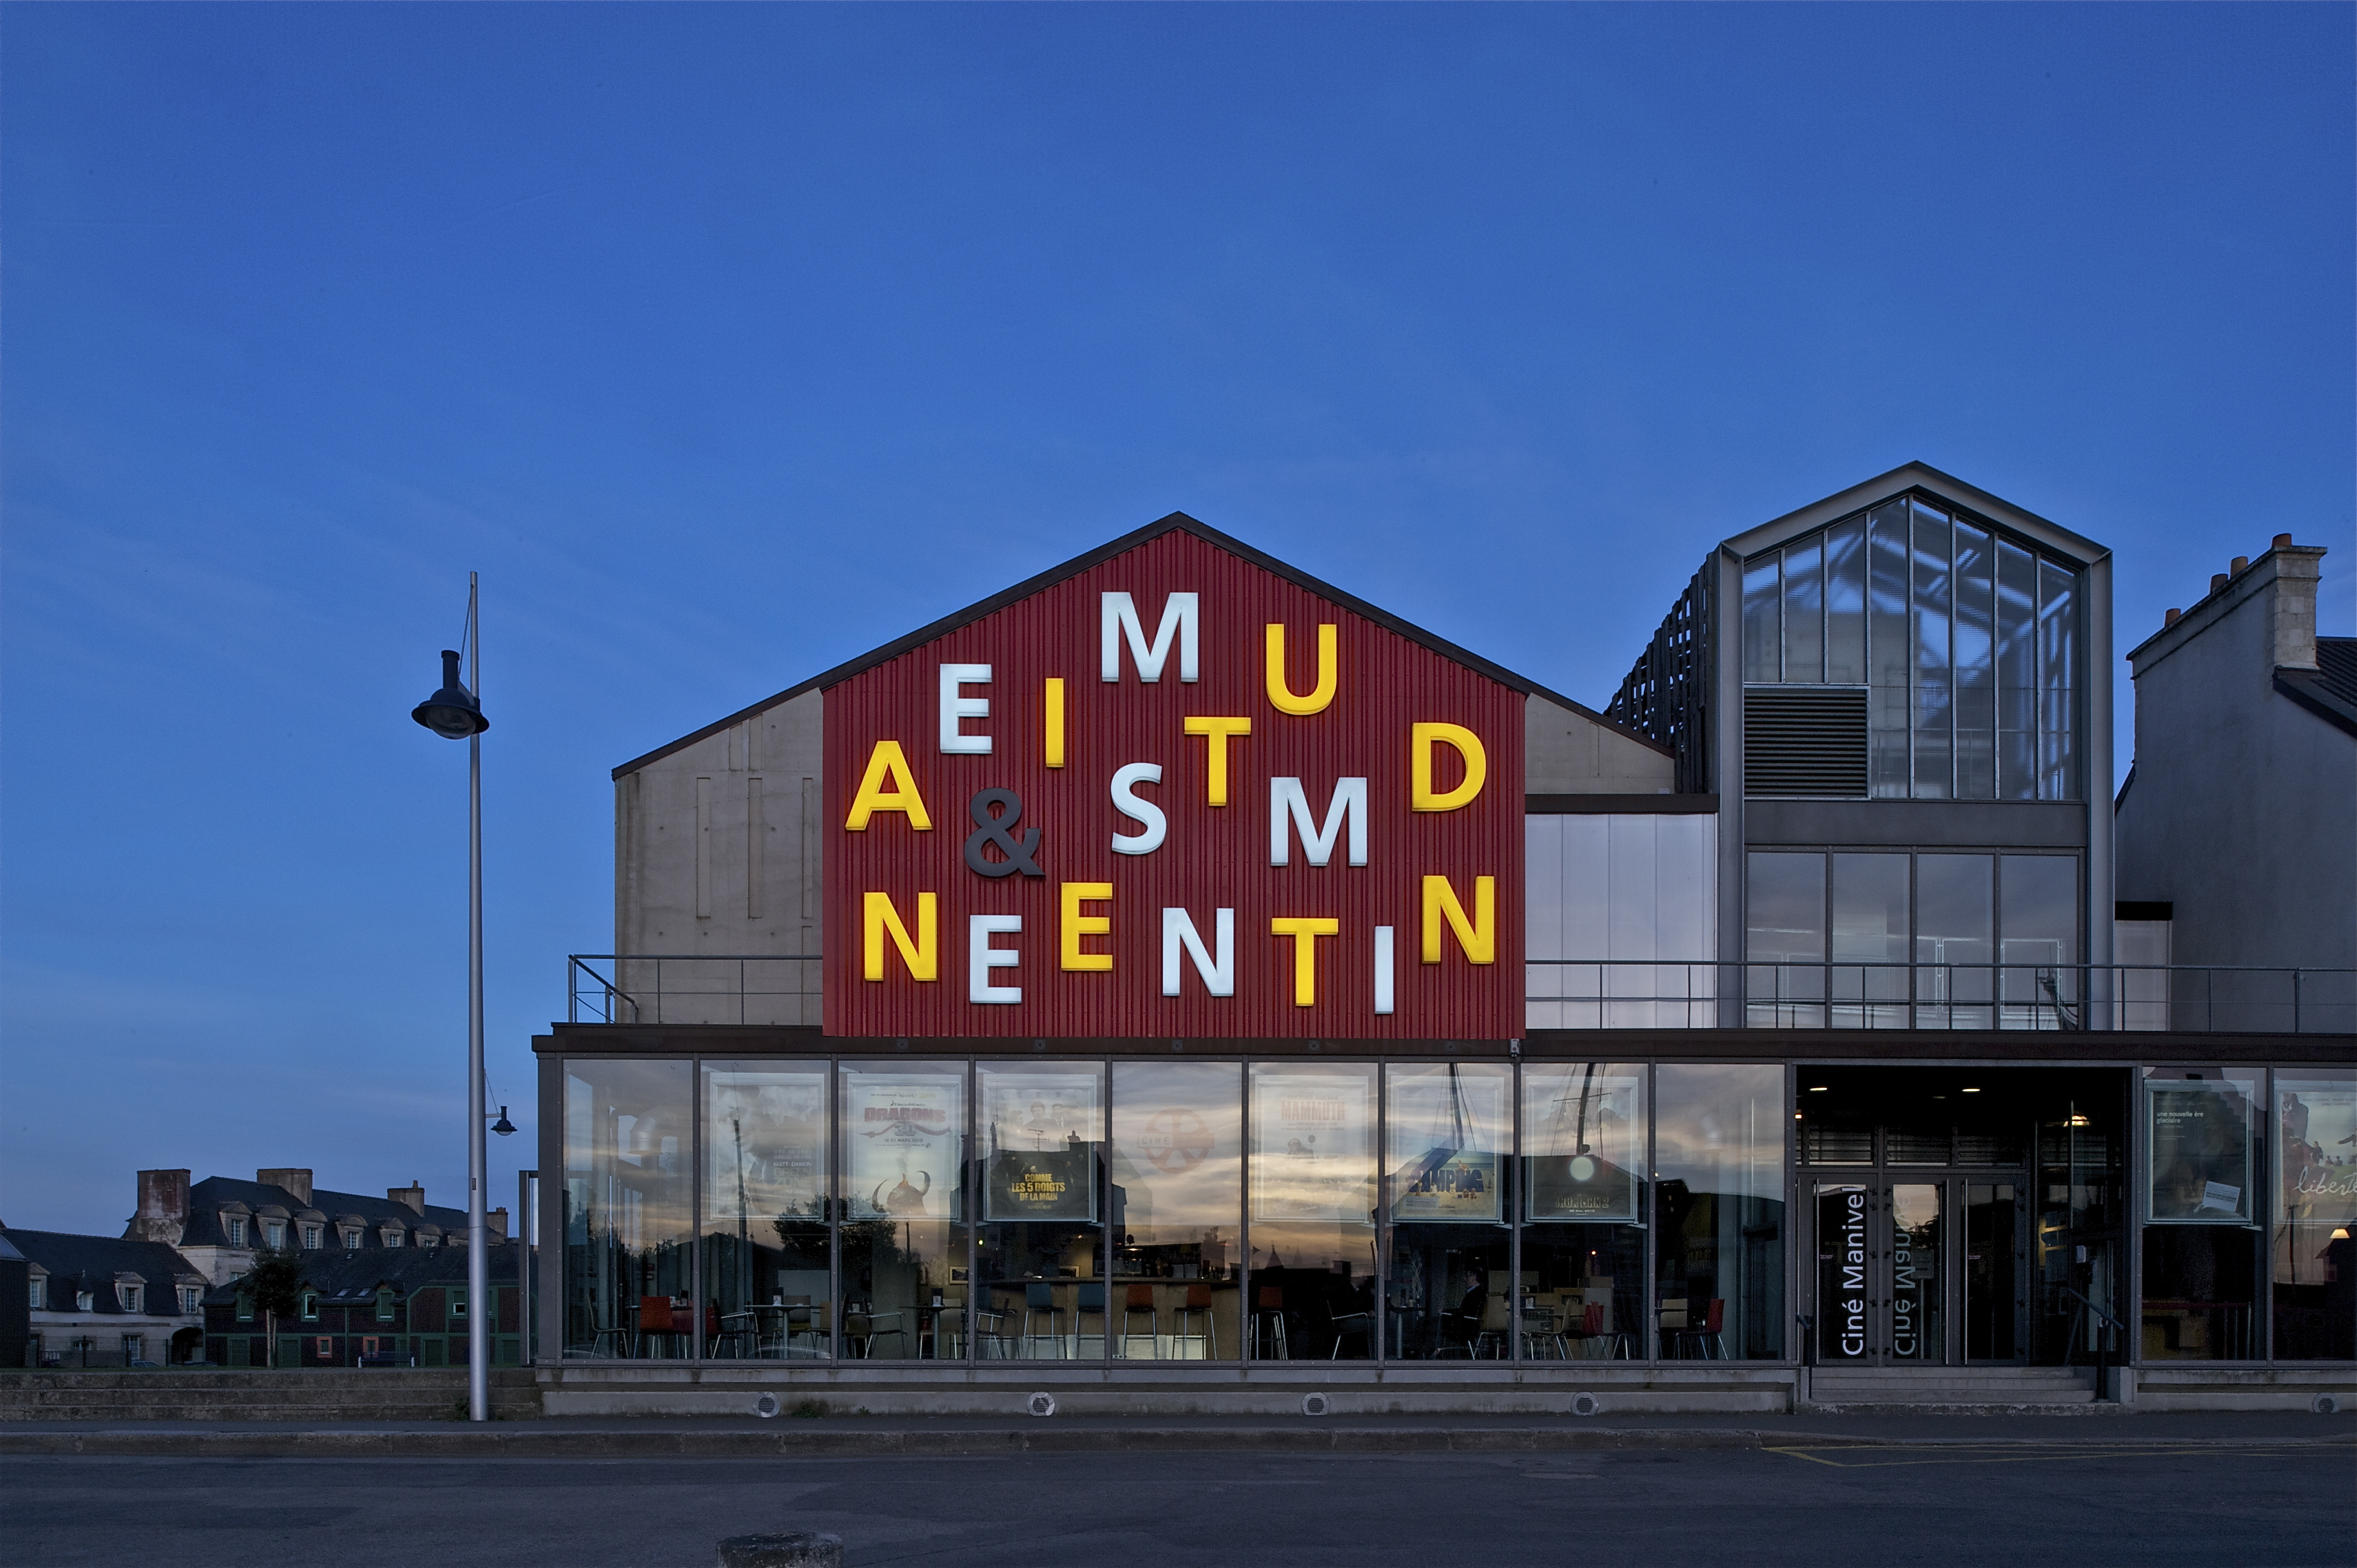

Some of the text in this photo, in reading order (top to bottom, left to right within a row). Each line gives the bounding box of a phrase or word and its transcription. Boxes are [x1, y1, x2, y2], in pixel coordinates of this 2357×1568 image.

[1102, 592, 1198, 682] M
[1266, 624, 1337, 715] U
[940, 664, 992, 754] E
[1046, 678, 1064, 767] I
[845, 740, 932, 831] A
[1185, 717, 1251, 806] T
[1412, 723, 1486, 811] D
[964, 787, 1045, 878] &
[1111, 763, 1166, 854] S
[1271, 777, 1367, 866] M
[864, 893, 937, 981] N
[970, 915, 1022, 1004] E
[1061, 883, 1113, 971] E
[1163, 907, 1234, 996] N
[1272, 918, 1339, 1006] T
[1422, 875, 1494, 964] N
[1375, 926, 1393, 1014] I
[864, 1107, 946, 1122] DRAGONS
[894, 1123, 916, 1136] 3D
[1281, 1101, 1345, 1121] MAMMUTH
[1011, 1182, 1066, 1192] LES 5 DOIGTS
[1019, 1192, 1058, 1201] DE LA MAIN
[1025, 1173, 1052, 1182] COMME
[1602, 1196, 1609, 1208] 2
[1841, 1188, 1864, 1355] Ciné Manivel
